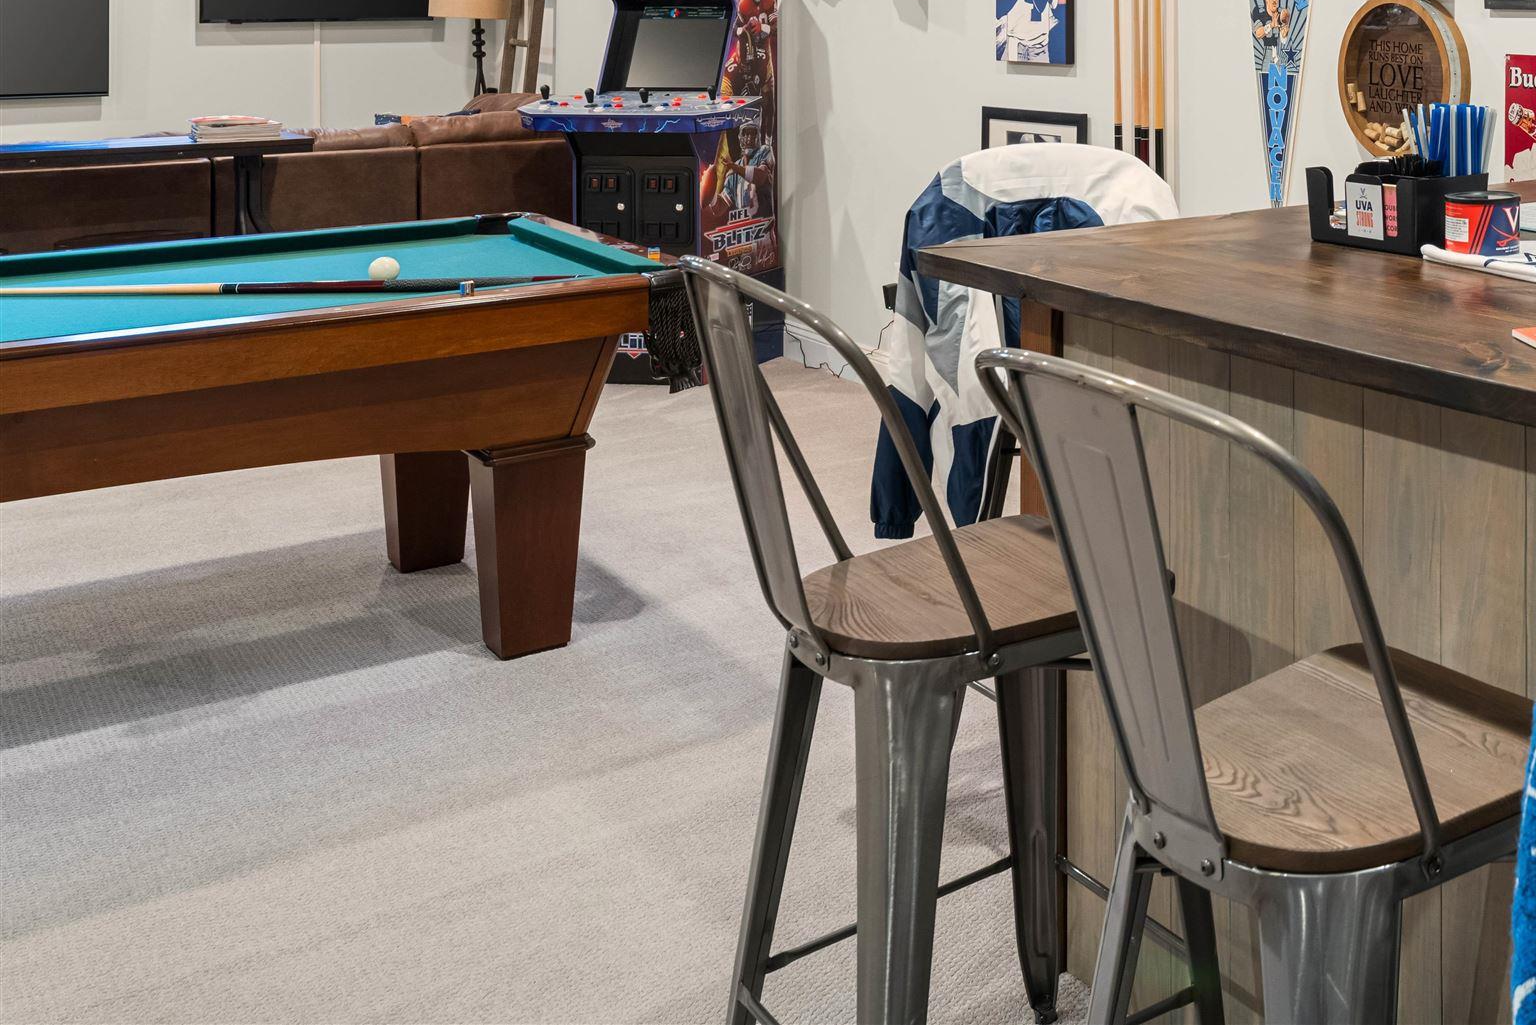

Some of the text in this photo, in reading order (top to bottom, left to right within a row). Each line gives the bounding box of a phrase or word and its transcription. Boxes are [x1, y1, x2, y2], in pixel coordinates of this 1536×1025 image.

[1369, 40, 1423, 55] THIS HOME
[1368, 51, 1423, 65] RUNS BEST ON
[1369, 62, 1424, 91] LOVE
[1368, 86, 1422, 104] LAUGHTER
[1369, 100, 1392, 114] AND
[1355, 200, 1373, 211] UVA
[729, 209, 750, 221] NFL
[1356, 211, 1374, 228] STRONG
[713, 224, 768, 252] BLITZ
